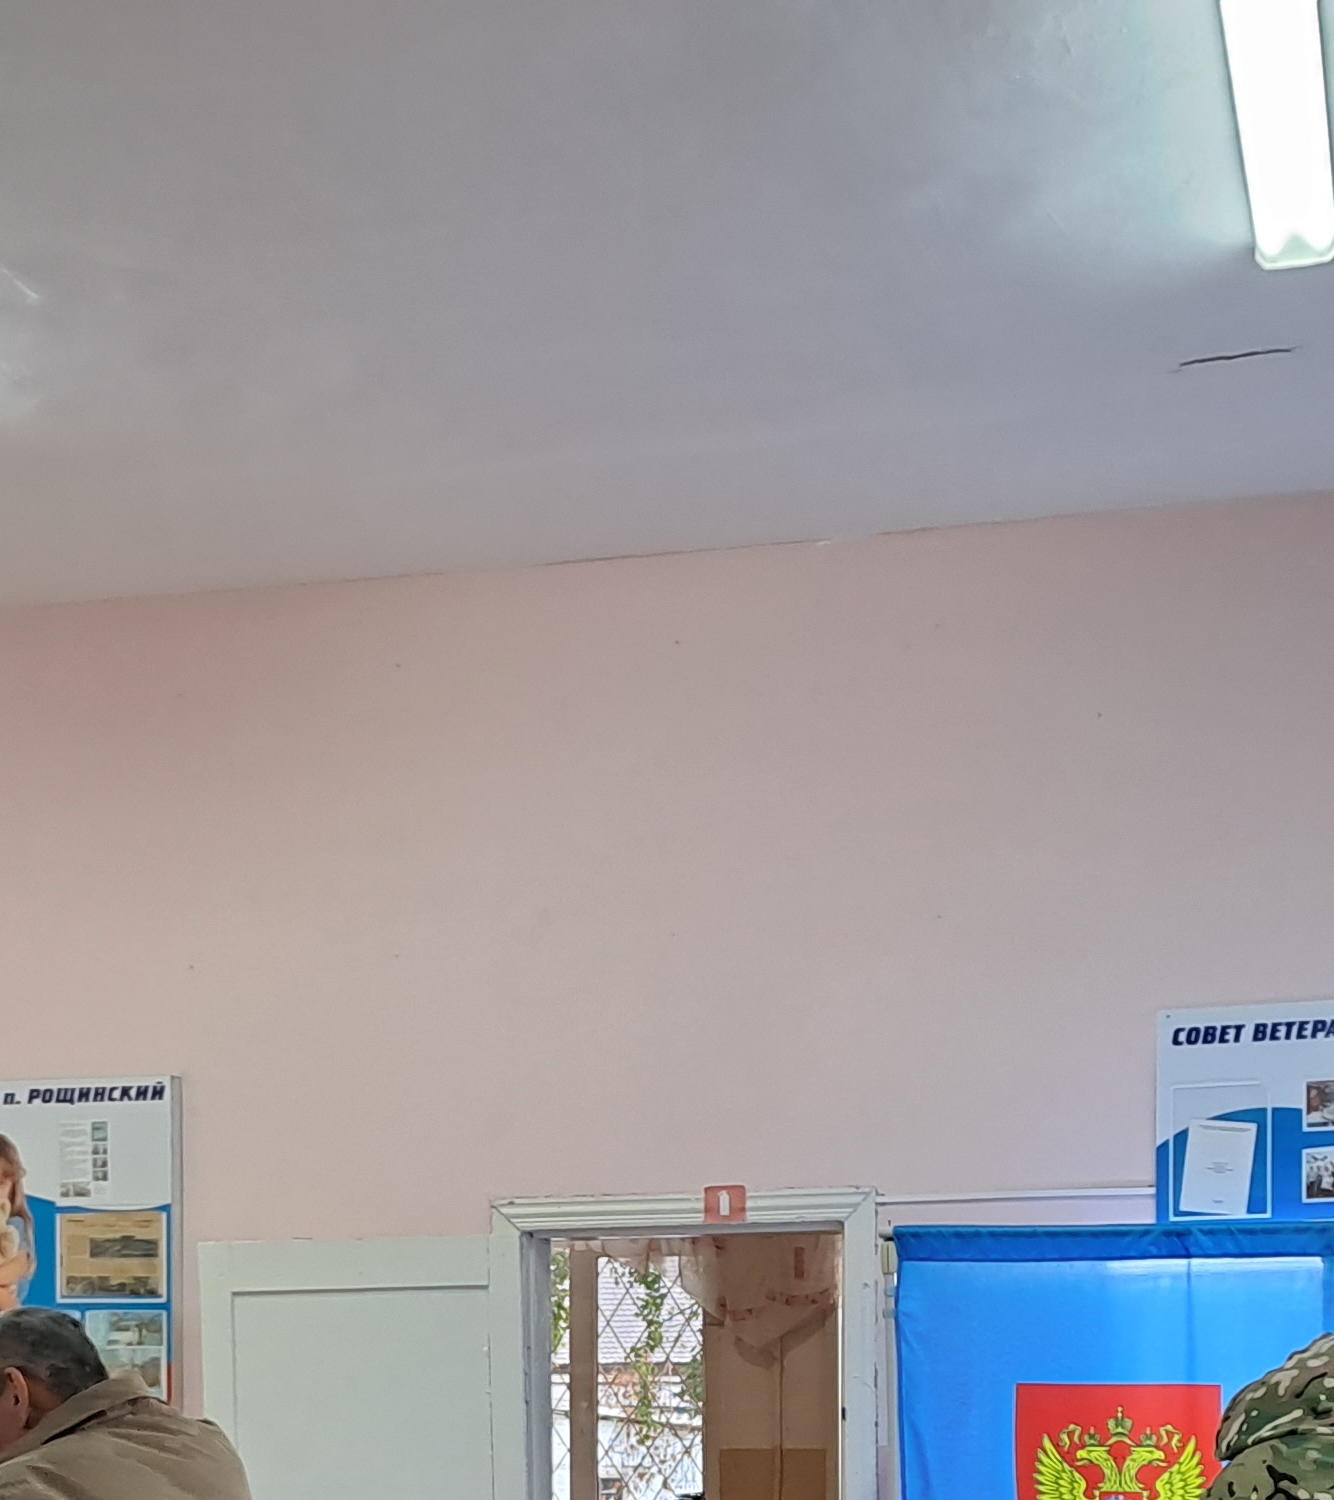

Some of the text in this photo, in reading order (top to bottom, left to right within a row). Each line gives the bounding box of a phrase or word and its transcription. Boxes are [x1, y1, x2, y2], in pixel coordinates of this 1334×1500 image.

[1171, 1023, 1247, 1046] СОВЕТ
[2, 1092, 22, 1106] п.
[27, 1081, 166, 1106] РОЩИНСКИЙ
